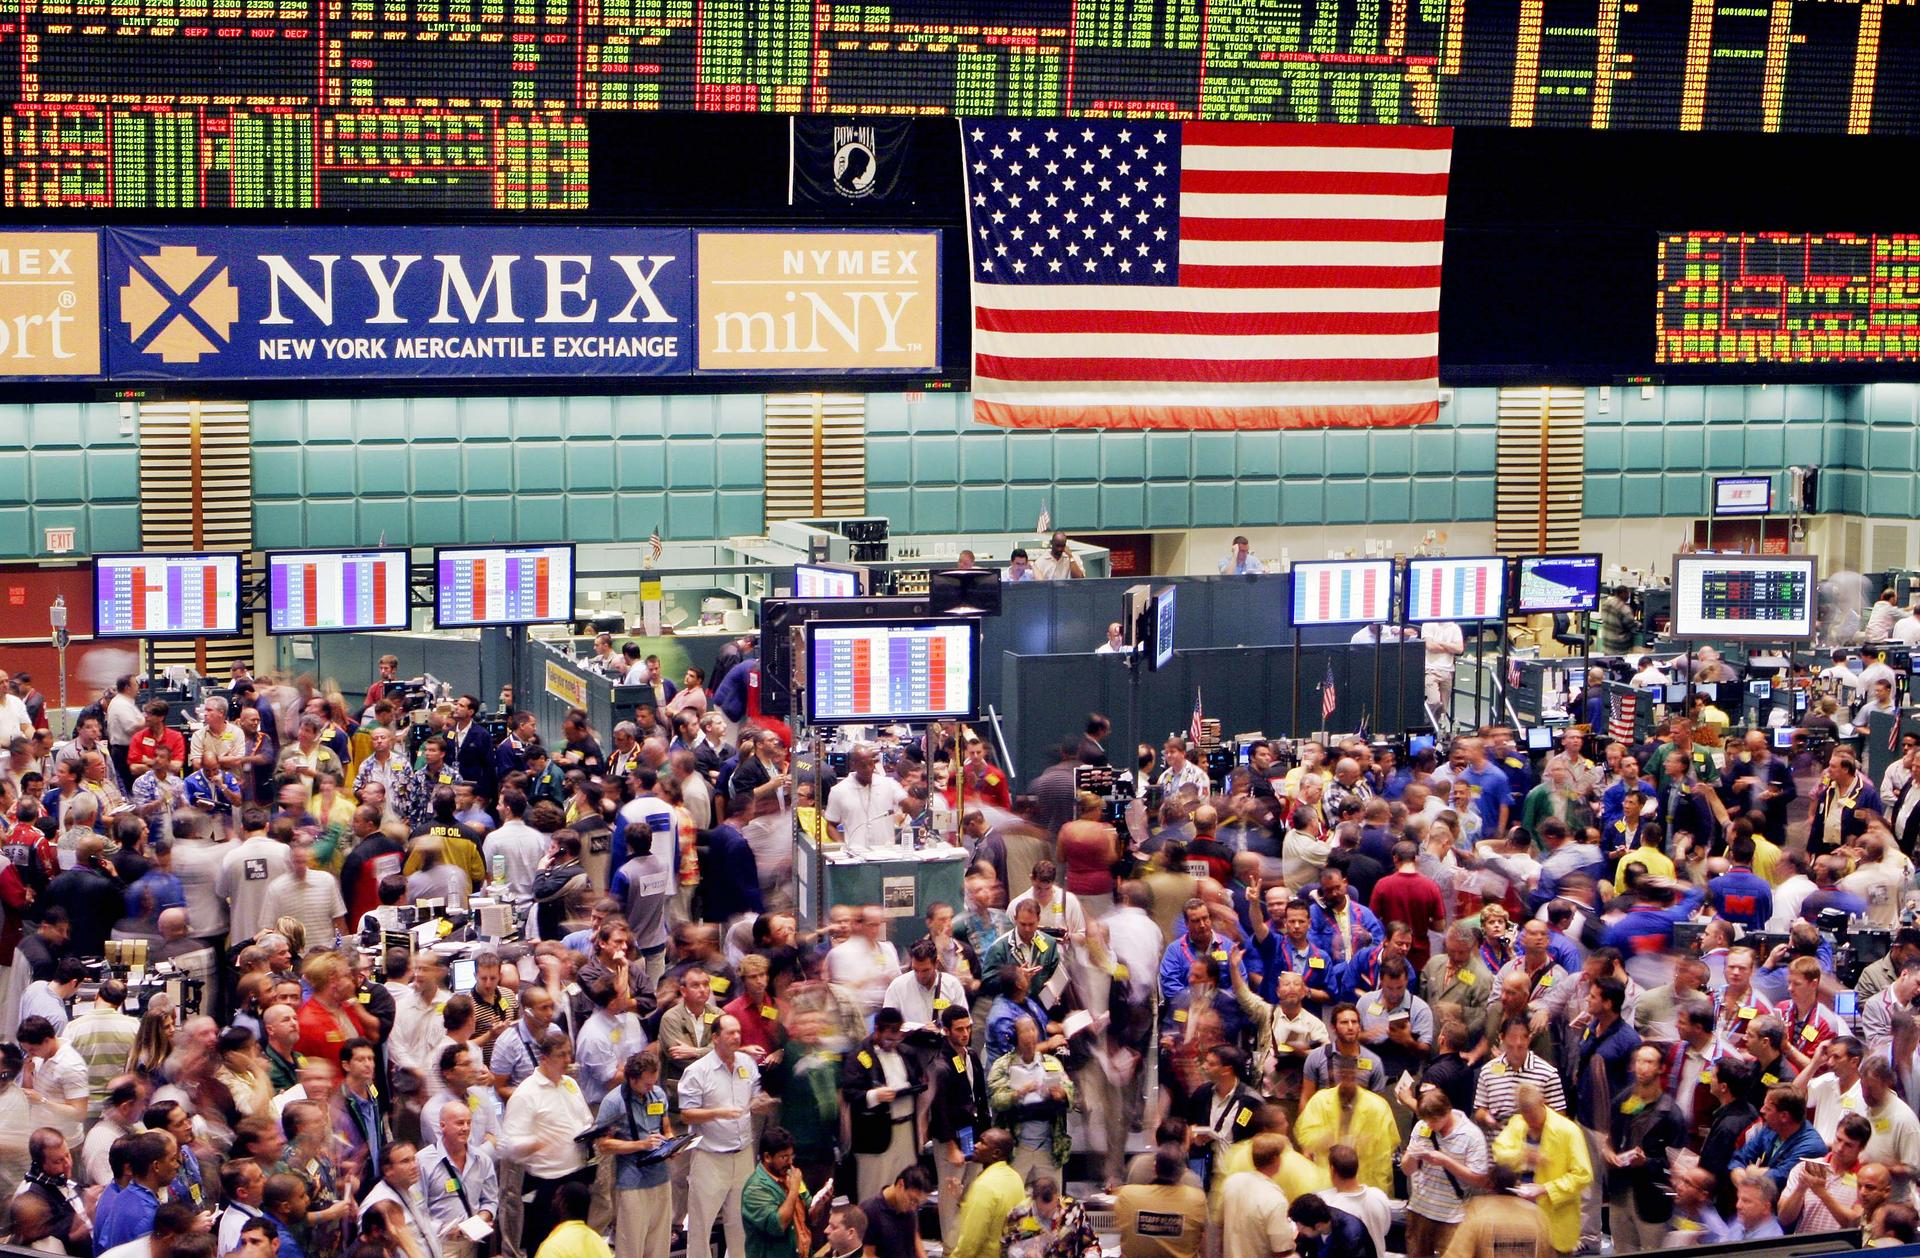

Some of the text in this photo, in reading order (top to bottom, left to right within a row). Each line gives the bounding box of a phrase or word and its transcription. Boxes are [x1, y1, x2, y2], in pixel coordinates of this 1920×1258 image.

[26, 5, 308, 19] ST 20804 21477 22037 22492 22867 23057 22977 22547
[865, 6, 890, 14] 22860
[330, 12, 341, 20] ST
[351, 12, 373, 20] 7491
[384, 13, 406, 21] 7618
[417, 13, 439, 21] 7695
[449, 14, 471, 22] 7751
[545, 16, 567, 24] 7857
[703, 11, 744, 19] 10:53:02
[157, 18, 179, 26] 2500
[603, 18, 630, 26] 22762
[83, 26, 106, 34] JUN7
[117, 27, 140, 35] JUL7
[151, 28, 175, 36] AUG7
[185, 28, 208, 36] SEP7
[218, 29, 242, 37] OCT7
[252, 29, 275, 37] NOV7
[285, 30, 308, 38] DEC7
[427, 23, 481, 32] LIMIT 1000
[650, 28, 671, 36] 2500
[1309, 28, 1337, 36] 1057.5
[384, 32, 406, 40] MAY7
[416, 33, 439, 41] JUN7
[449, 33, 471, 41] JUL7
[481, 34, 503, 42] AUG7
[512, 34, 535, 42] SEP7
[544, 35, 567, 43] OCT7
[639, 37, 661, 45] JAN7
[898, 43, 919, 51] JUL7
[928, 44, 949, 52] AUG7
[513, 53, 540, 62] 7915A
[1224, 52, 1248, 60] ALERT
[1278, 53, 1316, 61] NATIONAL
[1405, 57, 1438, 65] SUMMARY
[351, 60, 373, 68] 7890
[1205, 60, 1238, 68] (STOCKS
[1242, 61, 1279, 69] THOUSAND
[1404, 74, 1432, 82] CHANGE
[704, 85, 721, 93] FIX
[725, 85, 742, 93] SPD
[26, 94, 308, 105] ST 22097 21912 21992 22177 22392 22607 22862 23117
[1244, 96, 1272, 104] STOCKS
[1146, 102, 1175, 110] PRICES
[1233, 113, 1272, 121] CAPACITY
[834, 126, 876, 156] POW MIA
[783, 250, 918, 275] NYMEX
[257, 255, 678, 327] NYMEX
[712, 291, 919, 353] miNY
[259, 336, 678, 360] NEW YORK MERCANTILE EXCHANGE
[50, 533, 71, 549] EXIT
[430, 826, 461, 837] ARB OIL
